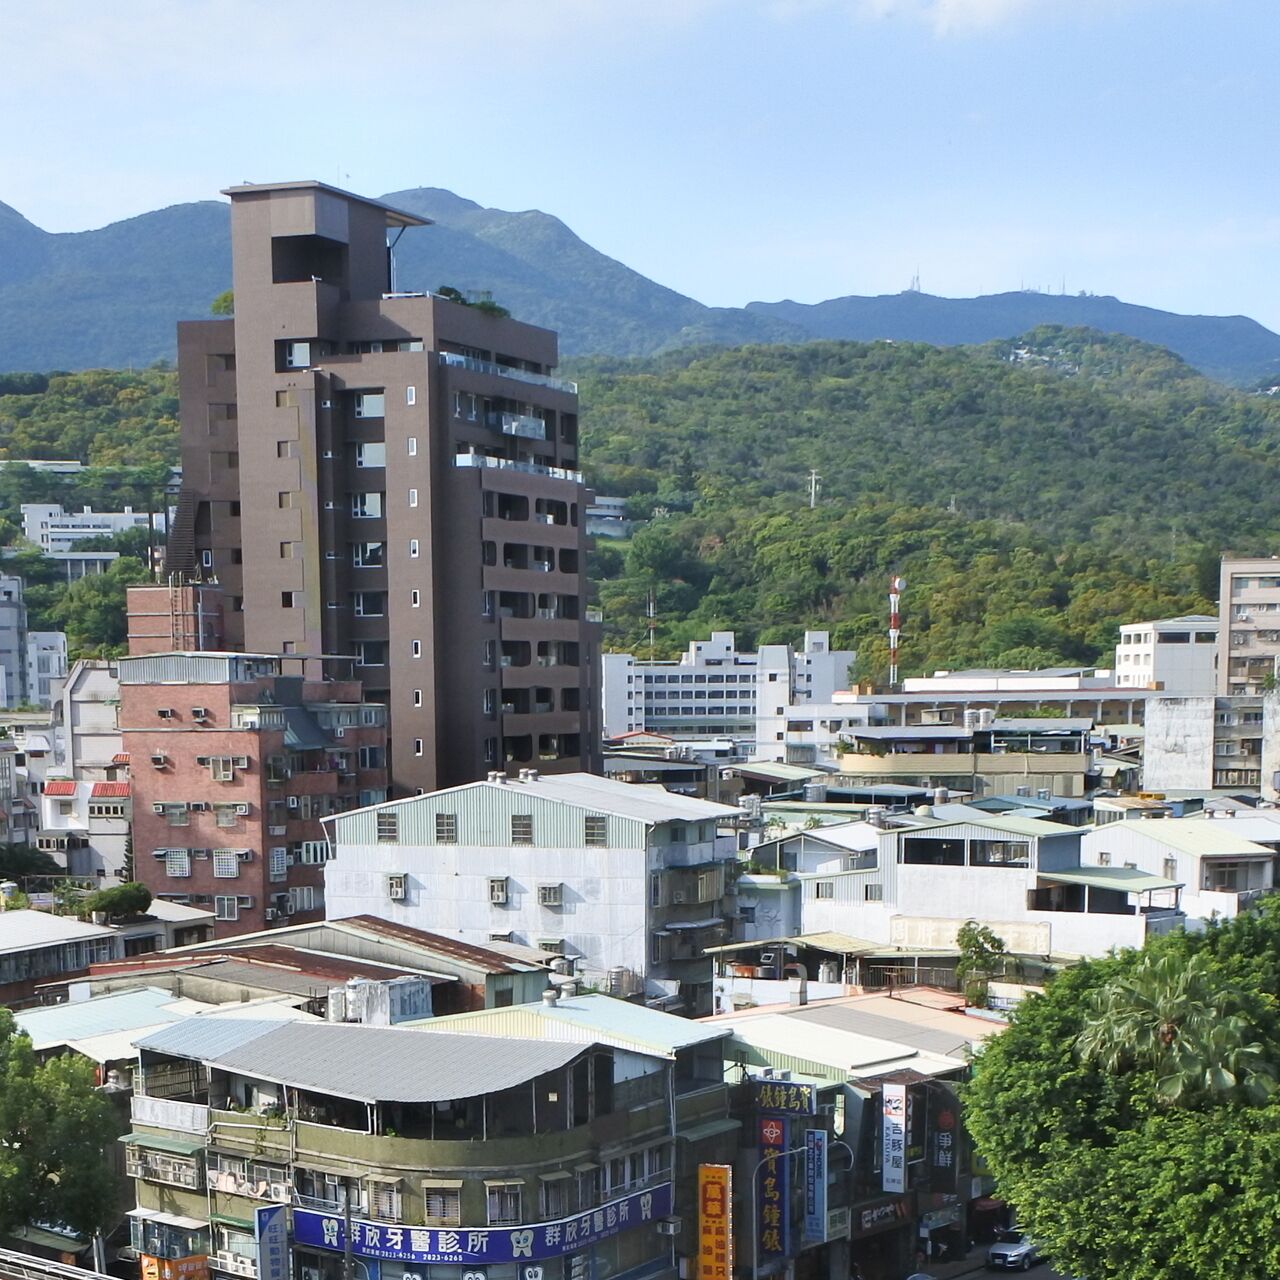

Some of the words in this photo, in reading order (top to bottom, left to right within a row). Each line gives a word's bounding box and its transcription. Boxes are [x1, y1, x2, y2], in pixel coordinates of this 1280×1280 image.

[545, 1201, 629, 1246] 群欣牙醫診所
[762, 1148, 783, 1252] 寶島鐘錶
